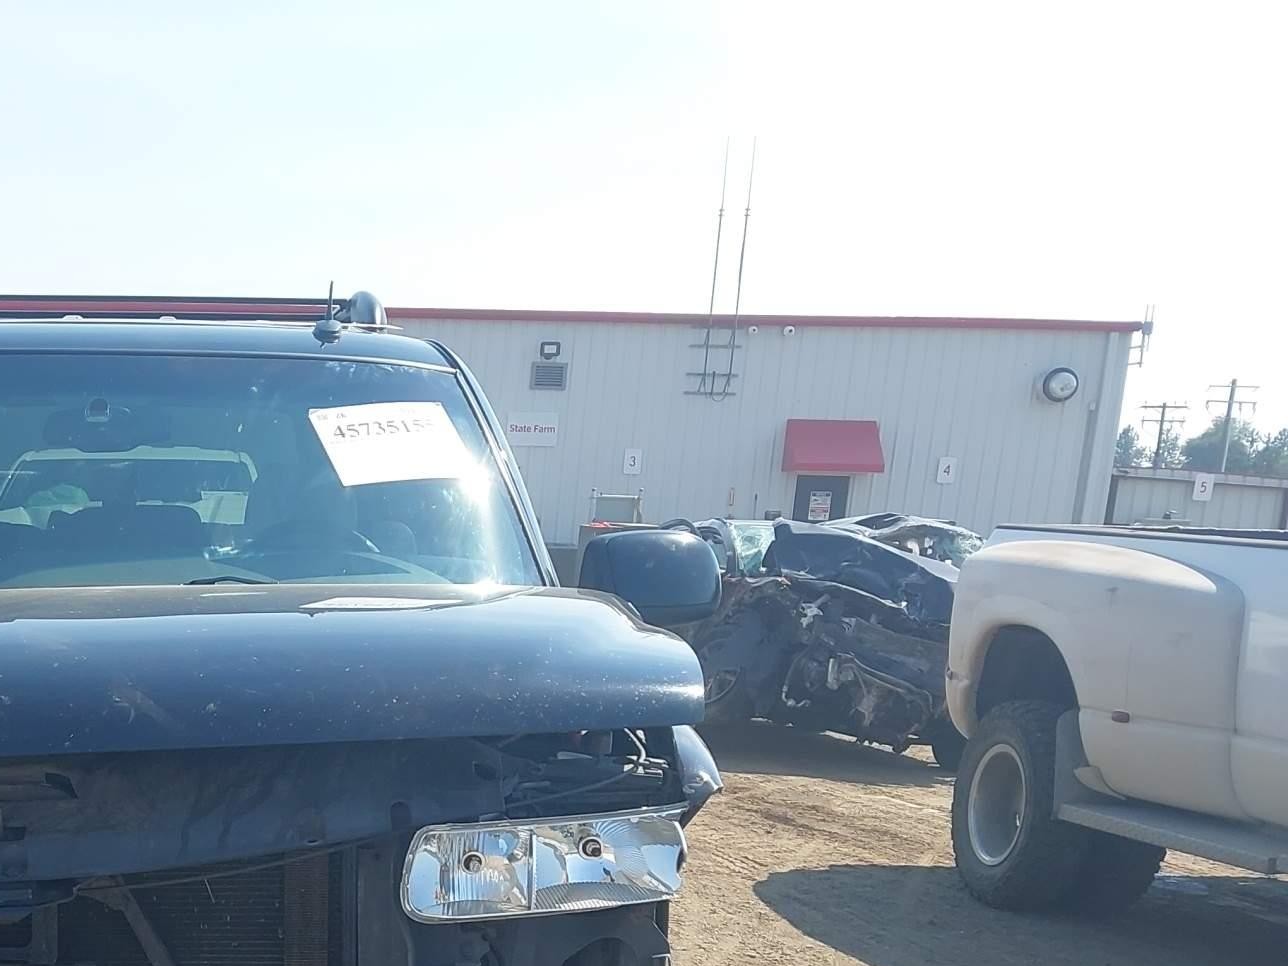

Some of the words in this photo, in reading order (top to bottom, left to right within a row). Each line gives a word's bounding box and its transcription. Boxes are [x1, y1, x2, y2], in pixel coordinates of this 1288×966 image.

[509, 423, 532, 433] State
[533, 424, 556, 433] Farm
[628, 455, 637, 467] 3
[943, 464, 951, 476] 4
[1199, 481, 1208, 493] 5
